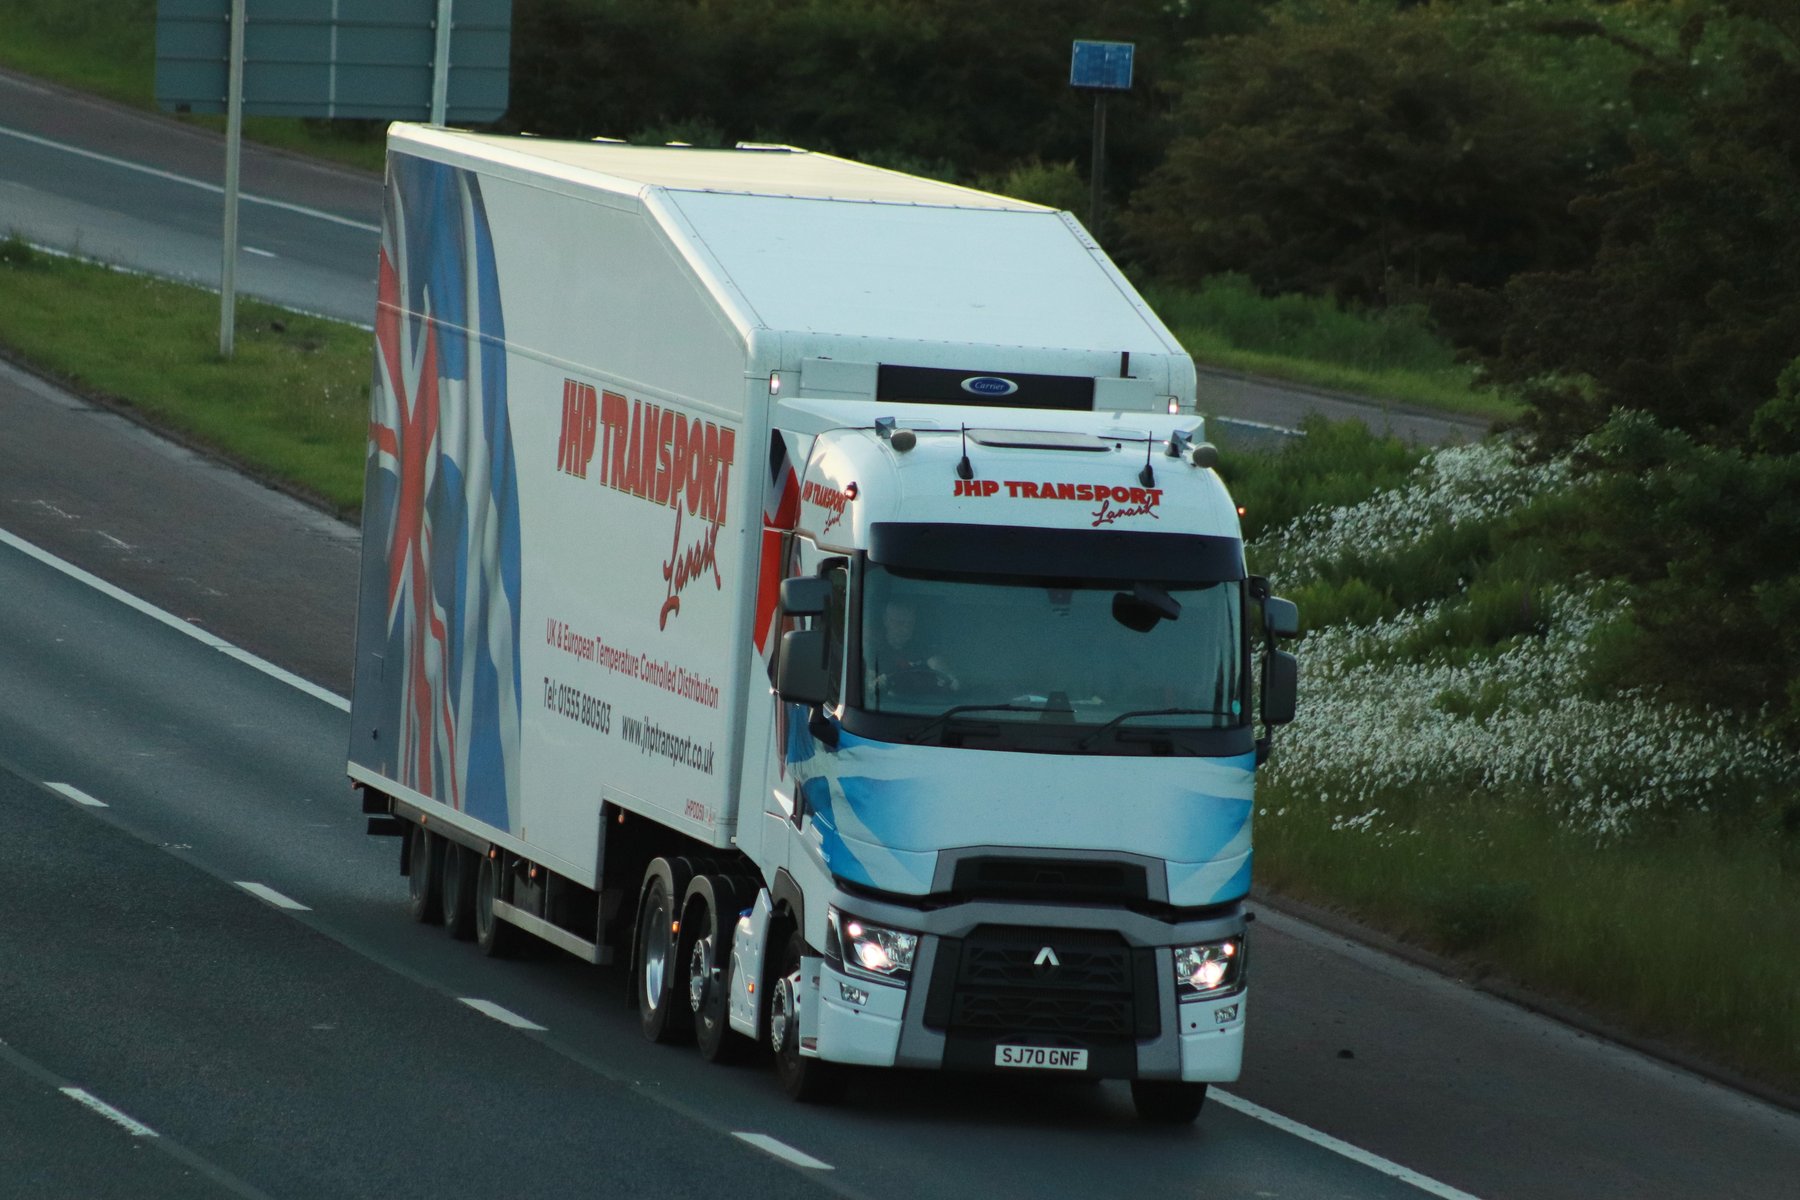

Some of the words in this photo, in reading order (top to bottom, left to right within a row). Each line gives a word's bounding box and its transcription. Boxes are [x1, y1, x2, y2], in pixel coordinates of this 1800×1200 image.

[974, 381, 1005, 391] Carrier
[557, 377, 597, 480] JHP
[600, 388, 736, 527] TRANSPORT
[953, 480, 999, 497] JHP
[1004, 481, 1163, 506] TRANSPORT
[1091, 497, 1159, 527] Lanark
[659, 472, 722, 631] Lanark
[546, 617, 557, 646] UK
[557, 621, 563, 649] &
[563, 623, 595, 662] European
[596, 636, 639, 678] Temperature
[640, 653, 677, 693] Controlled
[677, 666, 719, 709] Distribution
[544, 676, 557, 712] Tel:
[558, 683, 581, 722] 01555
[582, 693, 611, 735] 880503
[622, 715, 715, 775] www.jhptransport.co.uk
[1002, 1047, 1045, 1064] SJ70
[1049, 1050, 1081, 1066] GNF
